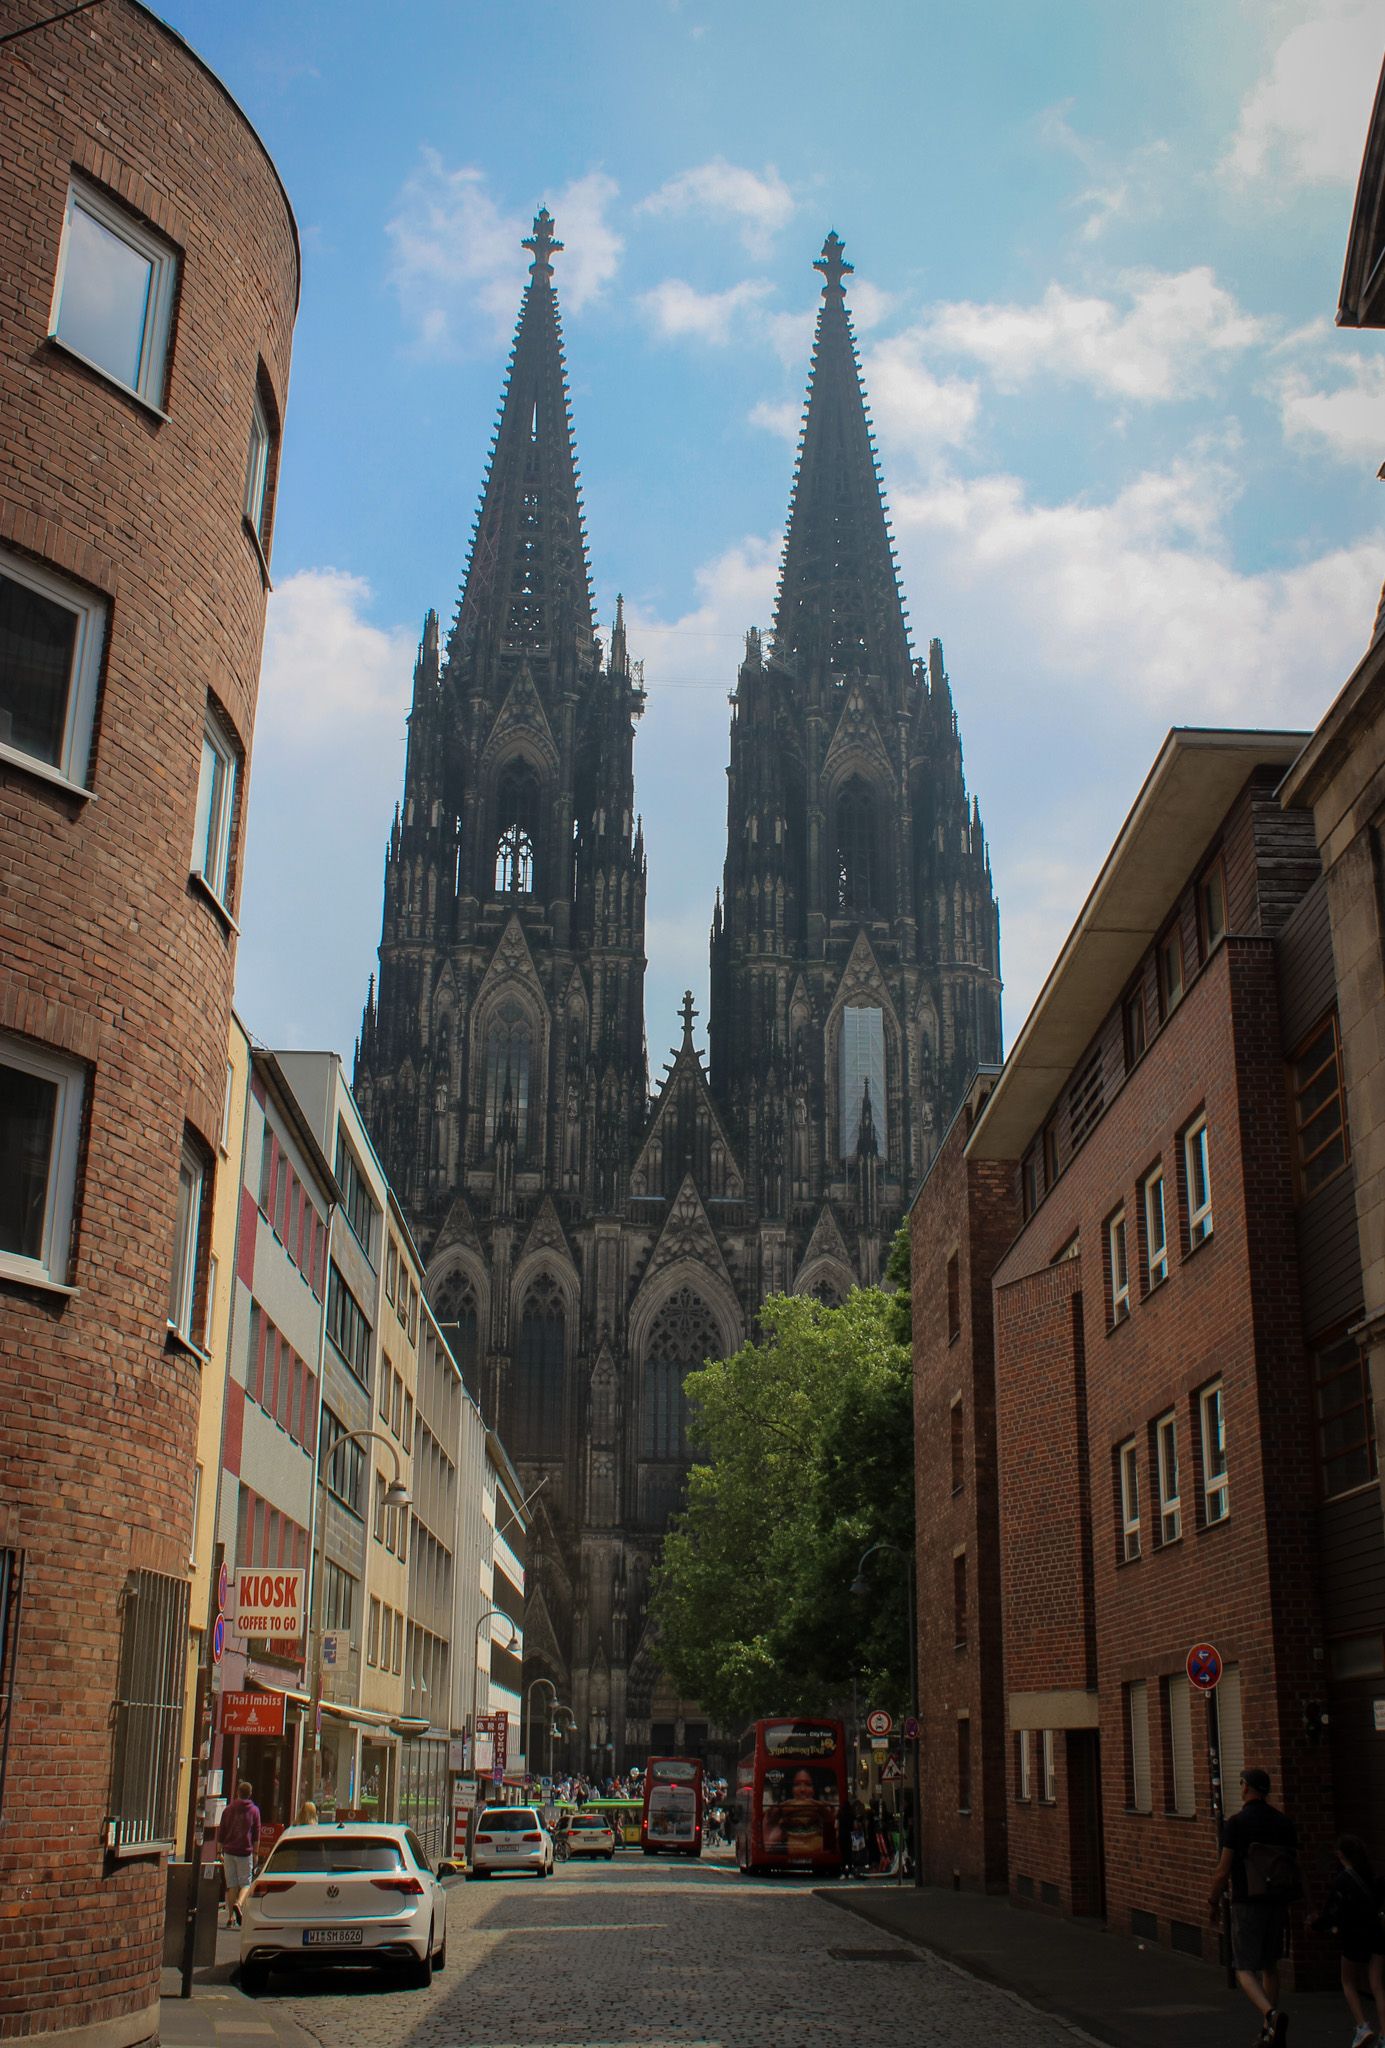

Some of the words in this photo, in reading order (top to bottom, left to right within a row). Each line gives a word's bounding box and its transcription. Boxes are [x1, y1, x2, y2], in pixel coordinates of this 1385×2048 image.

[240, 1576, 298, 1607] KIOSK
[239, 1616, 267, 1630] COFFEE
[270, 1616, 281, 1631] TO
[284, 1616, 296, 1631] GO
[227, 1694, 248, 1704] Thai
[250, 1695, 281, 1705] Imbiss
[340, 1930, 361, 1941] 8626
